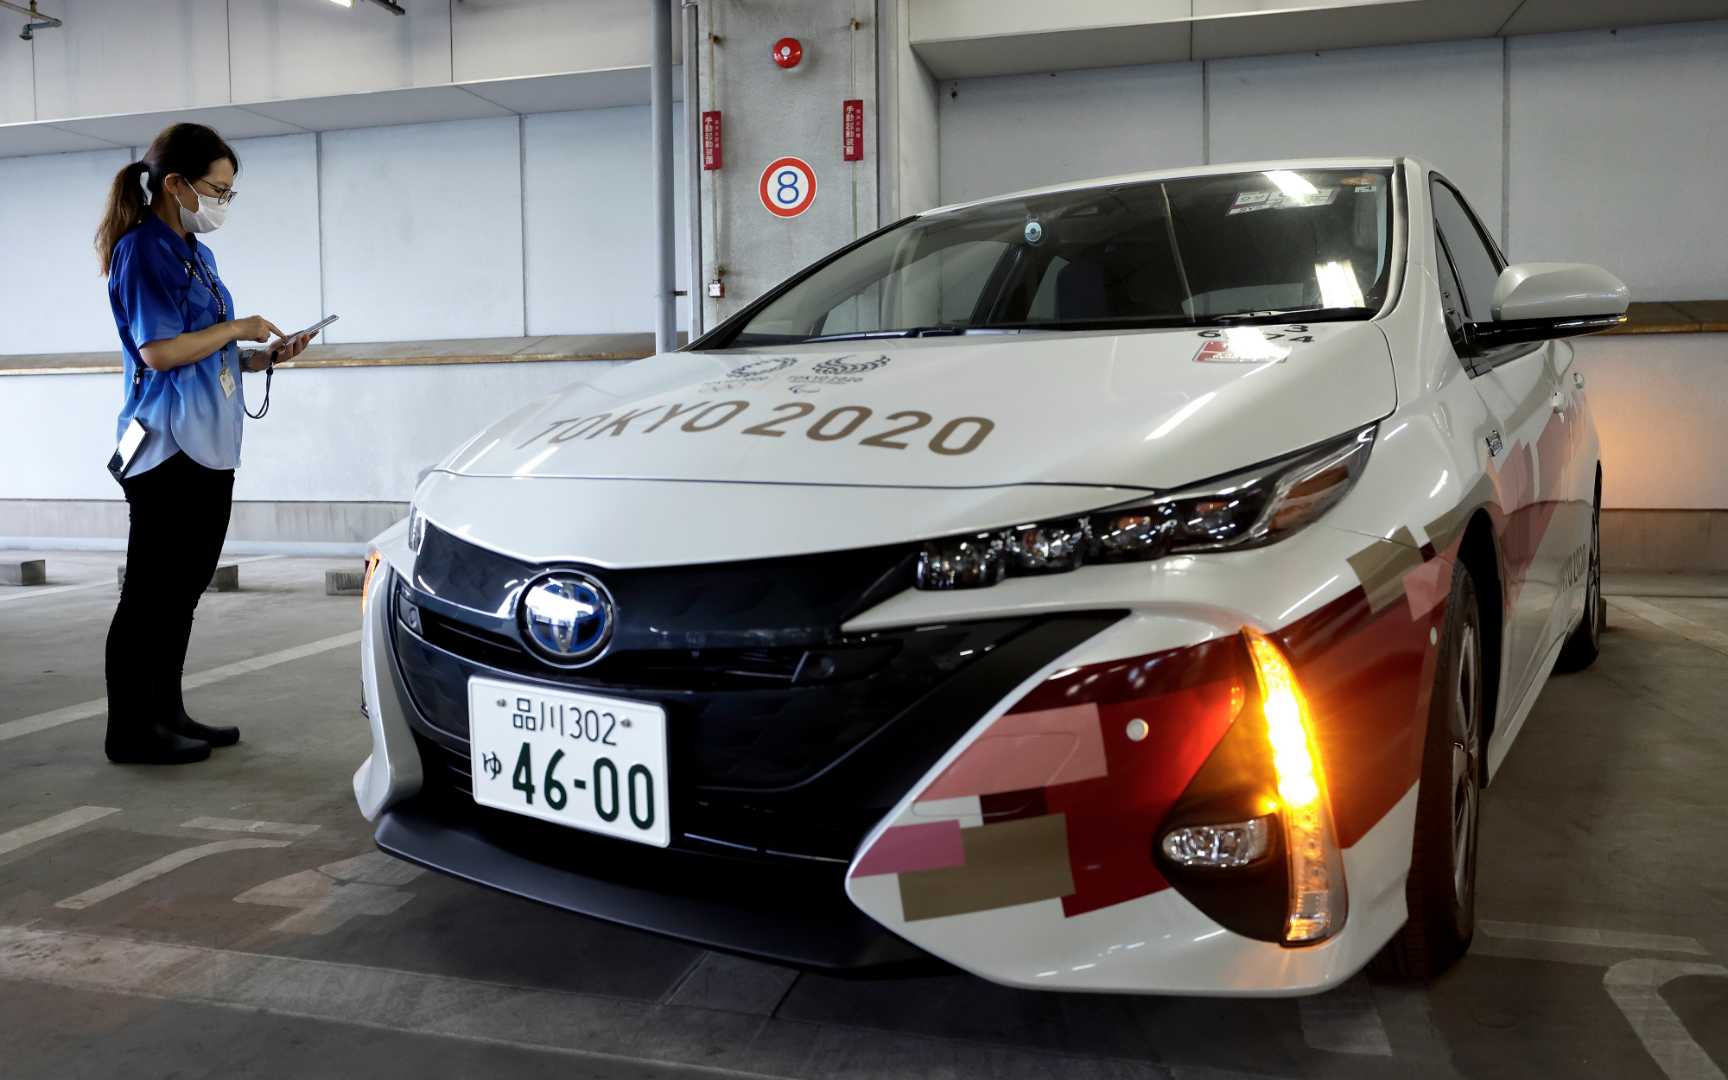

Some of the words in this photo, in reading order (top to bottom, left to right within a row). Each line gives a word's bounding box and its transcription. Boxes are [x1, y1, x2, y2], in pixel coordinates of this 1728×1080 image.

[777, 171, 799, 205] 8
[516, 400, 749, 450] TOKYO
[741, 402, 995, 456] 2020
[482, 751, 502, 780] ゆ
[512, 742, 655, 831] 46-00
